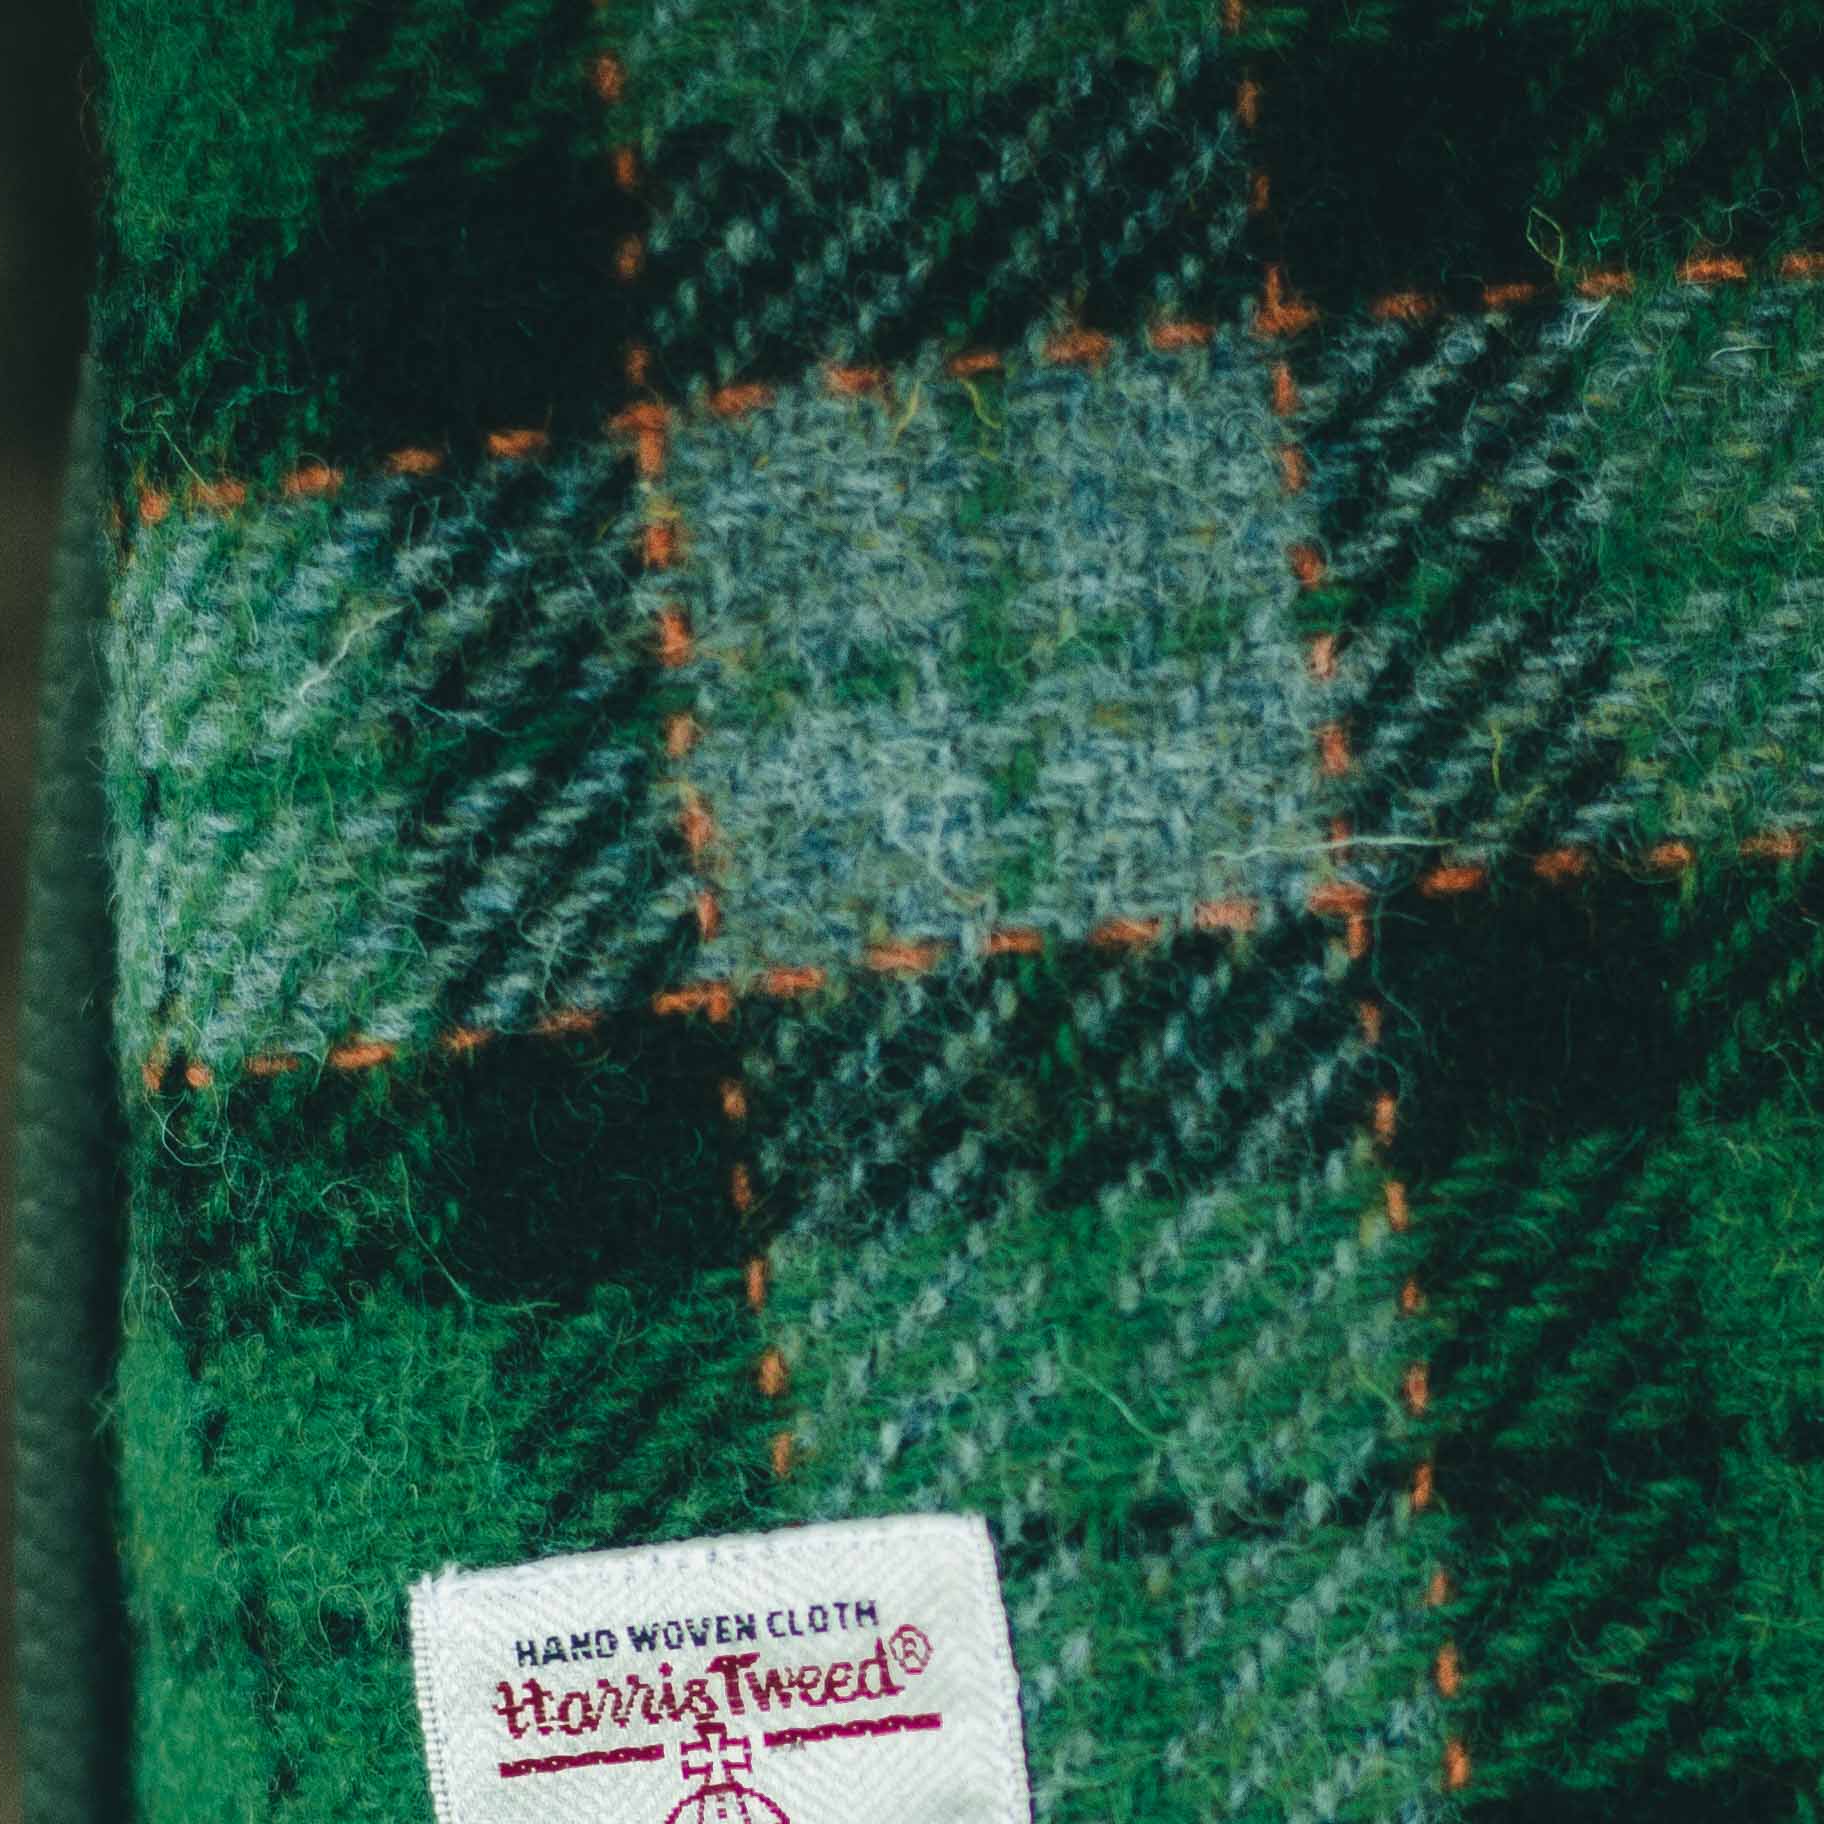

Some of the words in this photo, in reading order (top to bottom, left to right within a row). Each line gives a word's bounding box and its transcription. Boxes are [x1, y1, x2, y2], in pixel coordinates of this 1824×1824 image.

[515, 1627, 618, 1667] HAND
[627, 1612, 757, 1652] WOVEN
[767, 1600, 877, 1638] CLOTH
[493, 1663, 717, 1739] Harris
